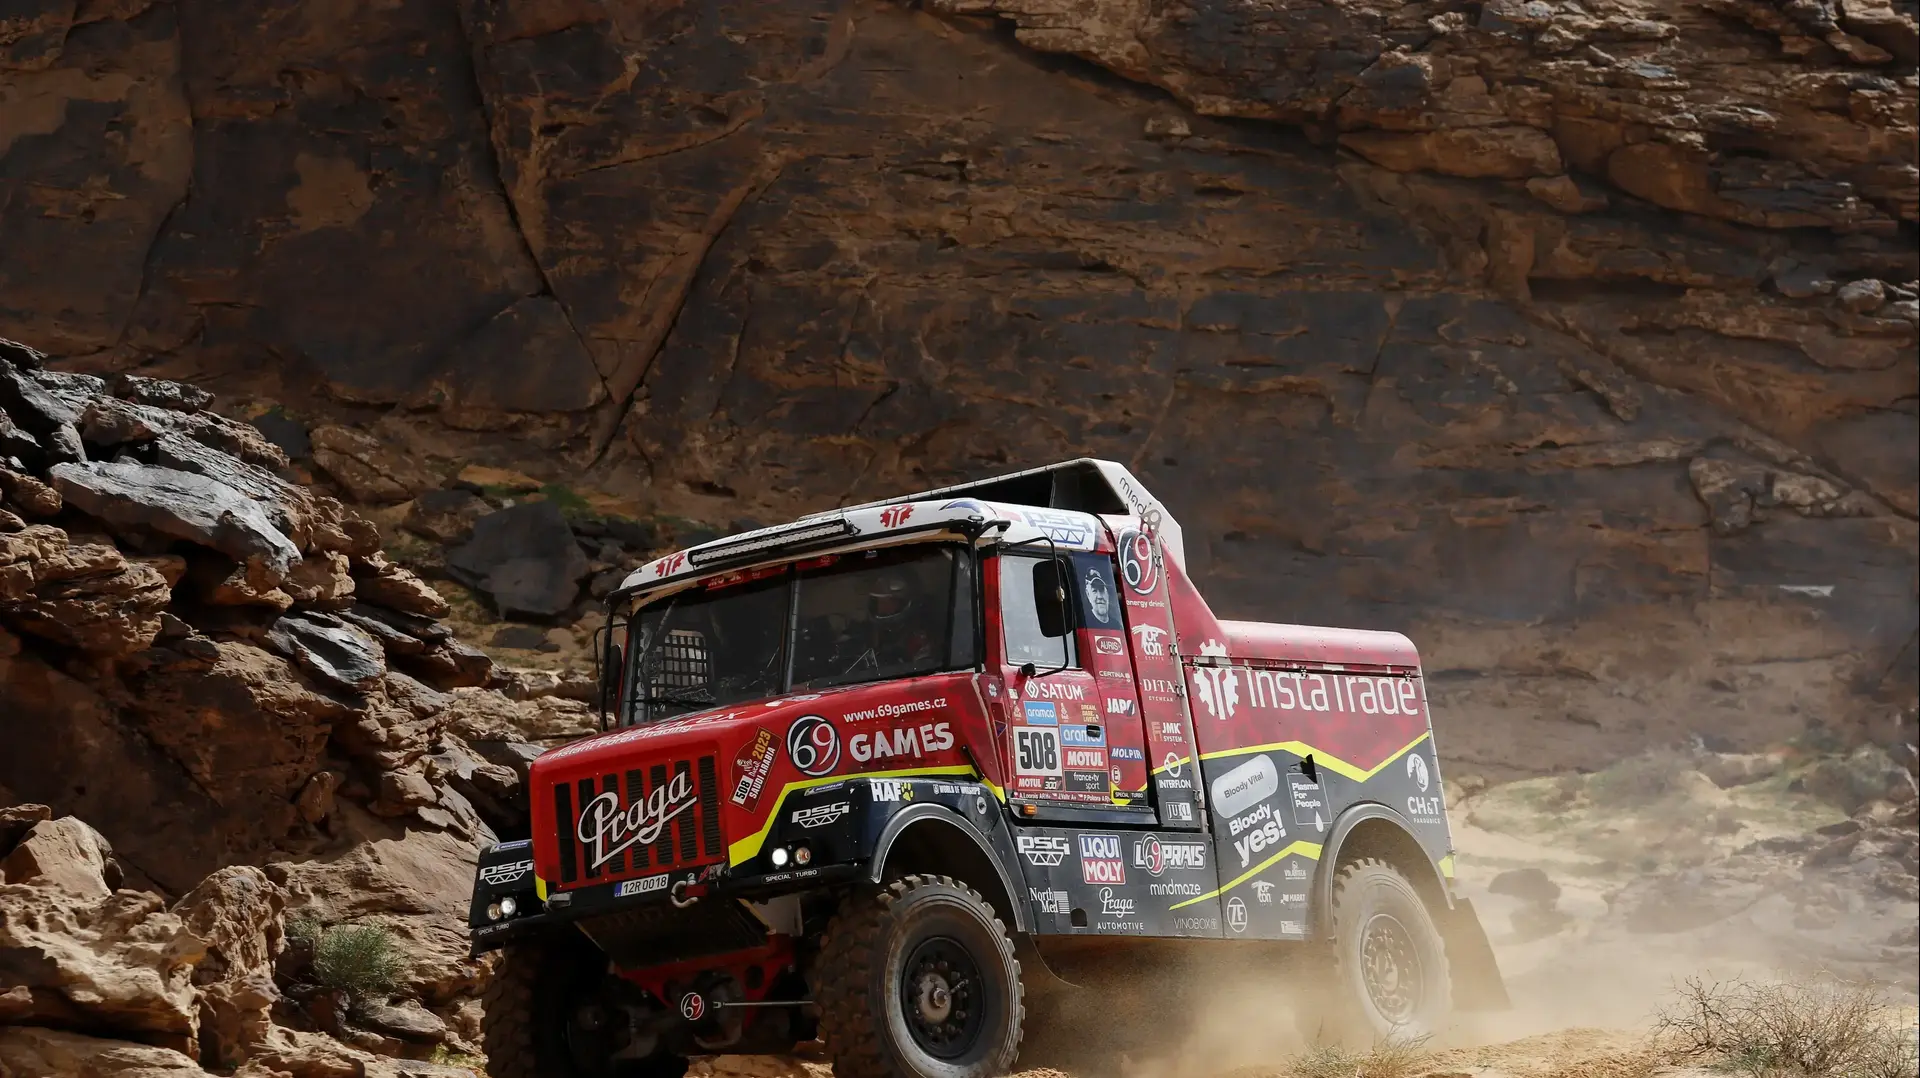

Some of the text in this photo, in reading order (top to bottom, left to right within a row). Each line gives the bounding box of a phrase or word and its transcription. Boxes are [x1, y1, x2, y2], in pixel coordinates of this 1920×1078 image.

[1122, 531, 1154, 587] 69
[1126, 599, 1165, 609] energy drink
[1100, 640, 1119, 651] AURIS
[1099, 671, 1125, 679] CERTINA
[1040, 683, 1084, 701] SATUM
[1143, 679, 1176, 693] DITA
[1245, 660, 1418, 716] InstaTrade
[843, 697, 947, 723] www.69games.cz
[1027, 708, 1055, 719] aramco
[1162, 722, 1181, 734] JMK
[752, 731, 771, 760] 2023
[791, 722, 954, 770] 69 GAMES
[1018, 731, 1057, 771] 508
[1111, 747, 1142, 759] MOLPIR
[1067, 751, 1104, 767] MOTUL
[749, 747, 776, 799] SAUDI ARABIA
[736, 780, 750, 800] 508
[1018, 778, 1042, 788] MOTUL
[1085, 782, 1100, 792] sport
[1159, 779, 1192, 789] INTERFLON
[1223, 772, 1264, 799] Bloody Vital
[1291, 782, 1319, 791] Plasma
[870, 782, 902, 802] HAF
[1293, 791, 1307, 799] For
[1295, 799, 1321, 809] People
[1407, 796, 1439, 815] CH&T
[577, 771, 697, 869] Praga
[1228, 803, 1271, 836] Bloody
[1234, 809, 1287, 868] yes!
[1080, 837, 1120, 859] LIQUI
[765, 869, 818, 883] SPECIAL TURBO
[1085, 861, 1122, 882] MOLY
[623, 876, 667, 894] 12R 0018
[1150, 879, 1201, 896] mindmaze
[1030, 888, 1054, 901] North
[1099, 886, 1135, 918] Praga
[1041, 900, 1059, 913] Med
[1174, 918, 1211, 930] VINOBOX
[1229, 906, 1244, 925] ZF
[496, 922, 510, 931] TURBO
[1097, 921, 1144, 930] AUTOMOTIVE
[682, 993, 704, 1019] 69
